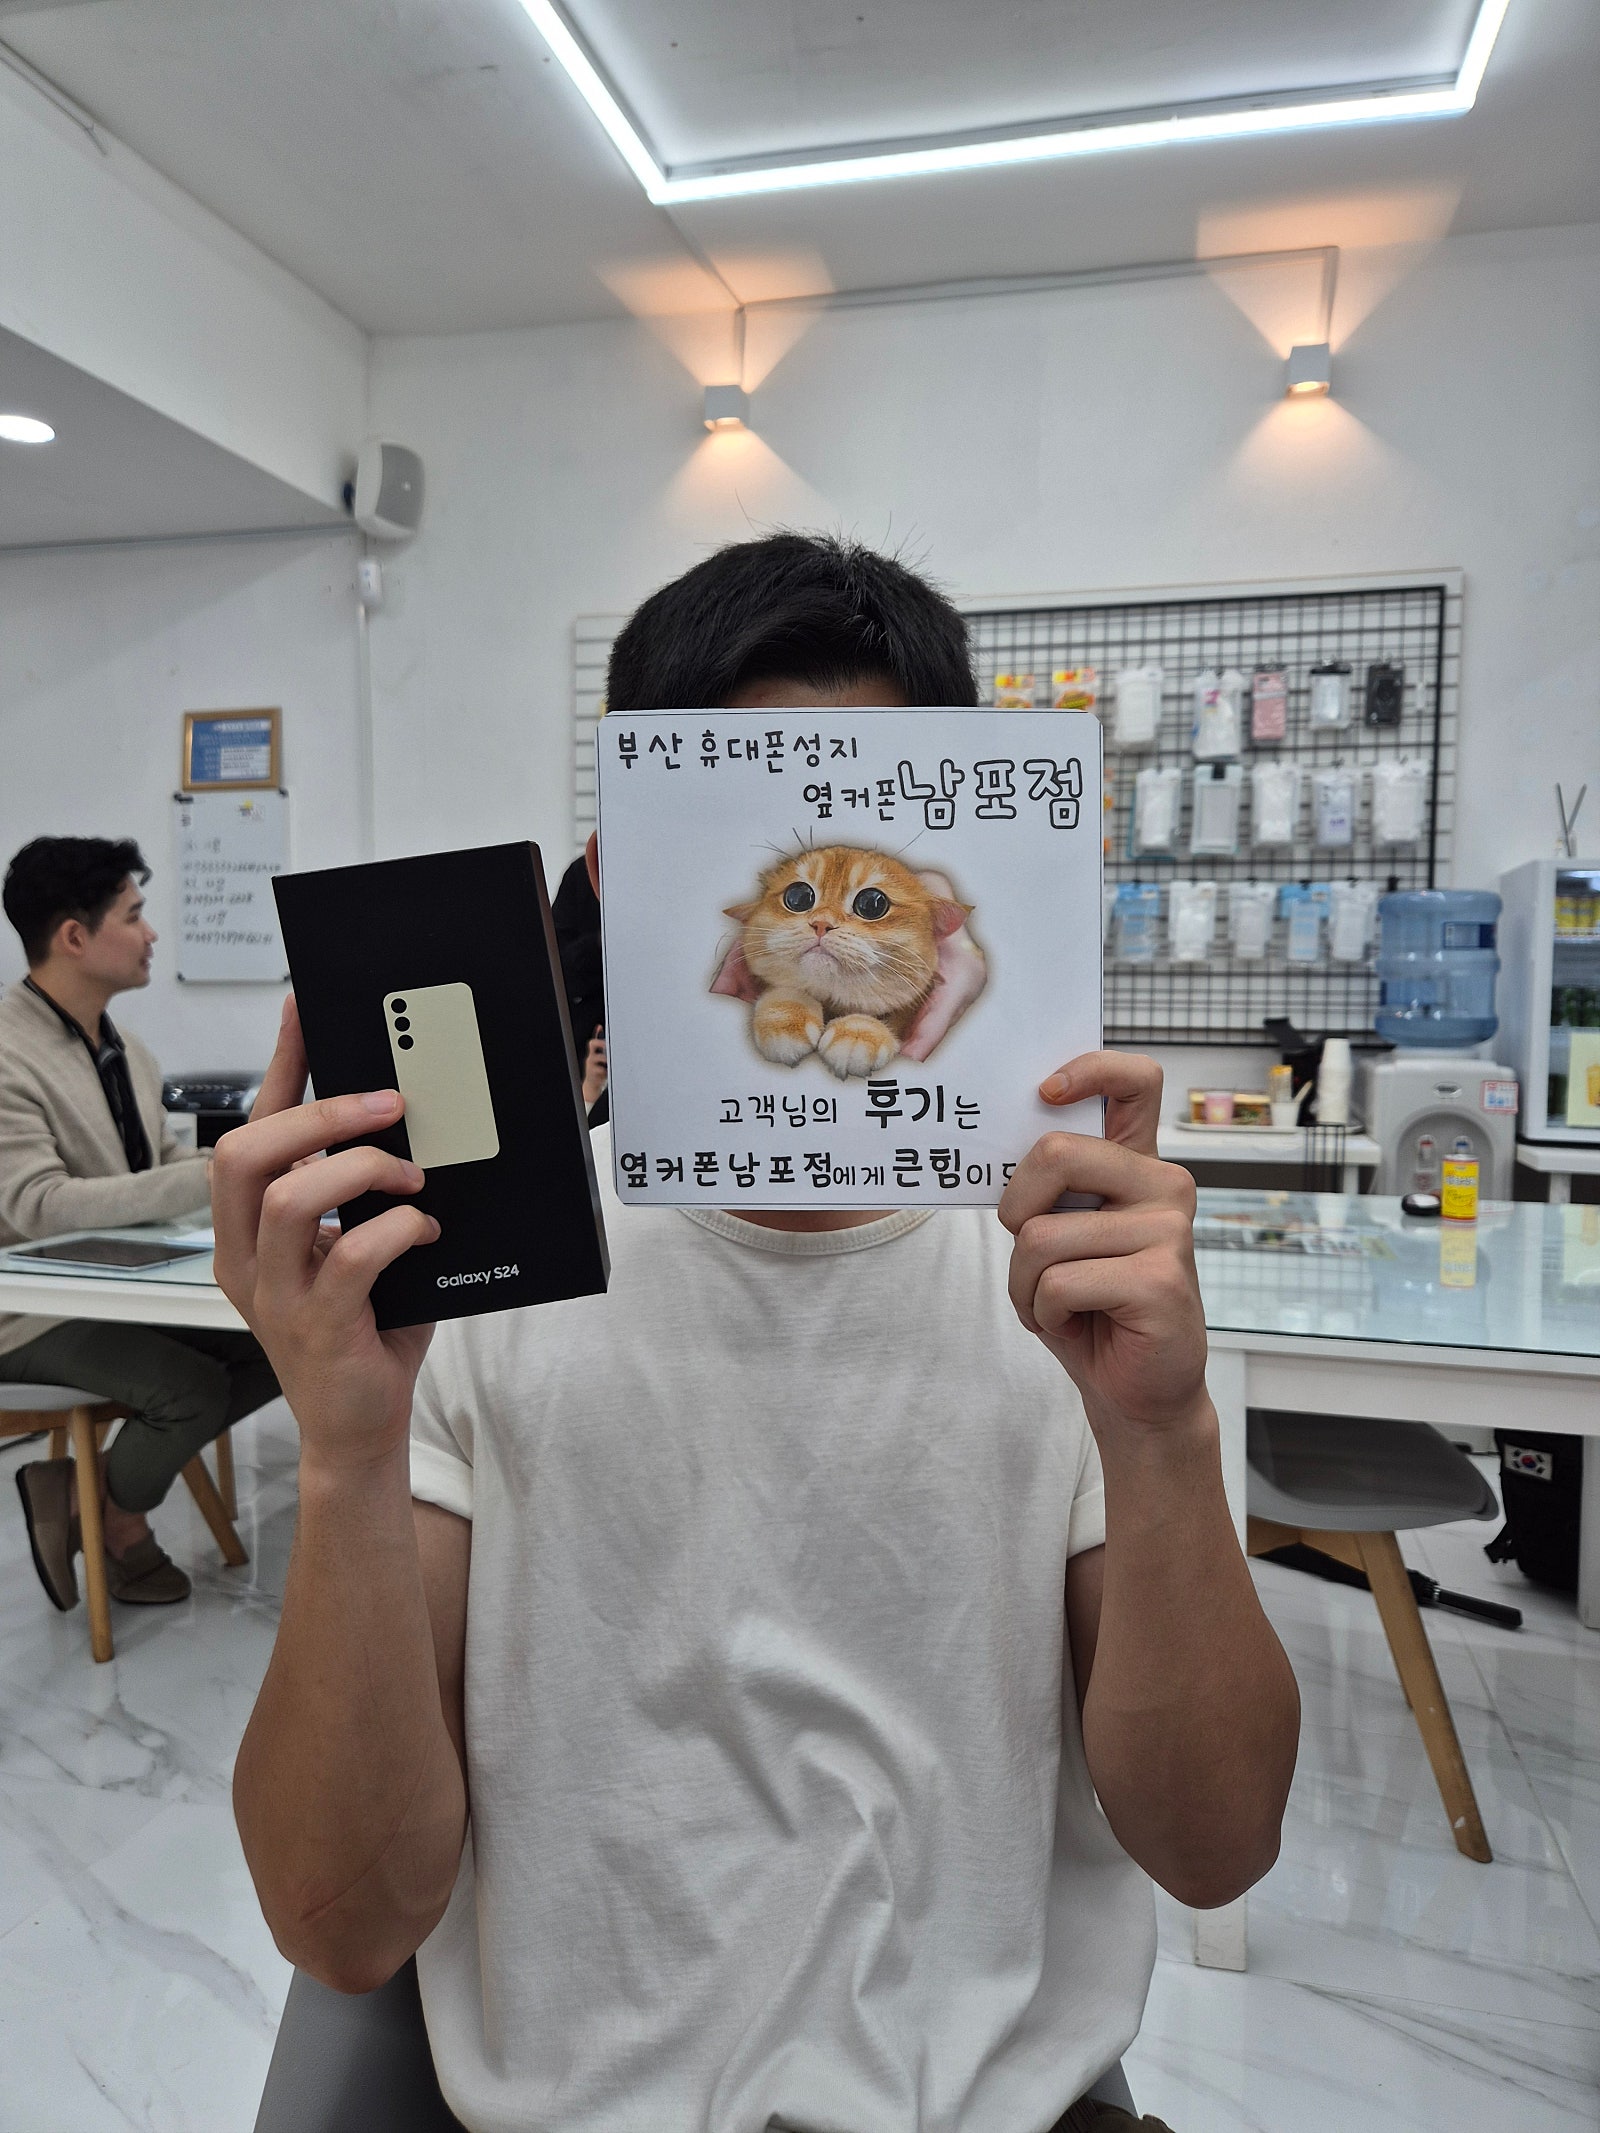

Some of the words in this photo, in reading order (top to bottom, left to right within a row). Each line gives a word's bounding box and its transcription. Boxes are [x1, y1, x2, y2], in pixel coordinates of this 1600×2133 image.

[618, 731, 683, 770] 부산
[699, 729, 858, 774] 휴대폰성지
[719, 1094, 837, 1128] 고객님의
[436, 1270, 492, 1289] Galaxy
[493, 1263, 520, 1279] S24
